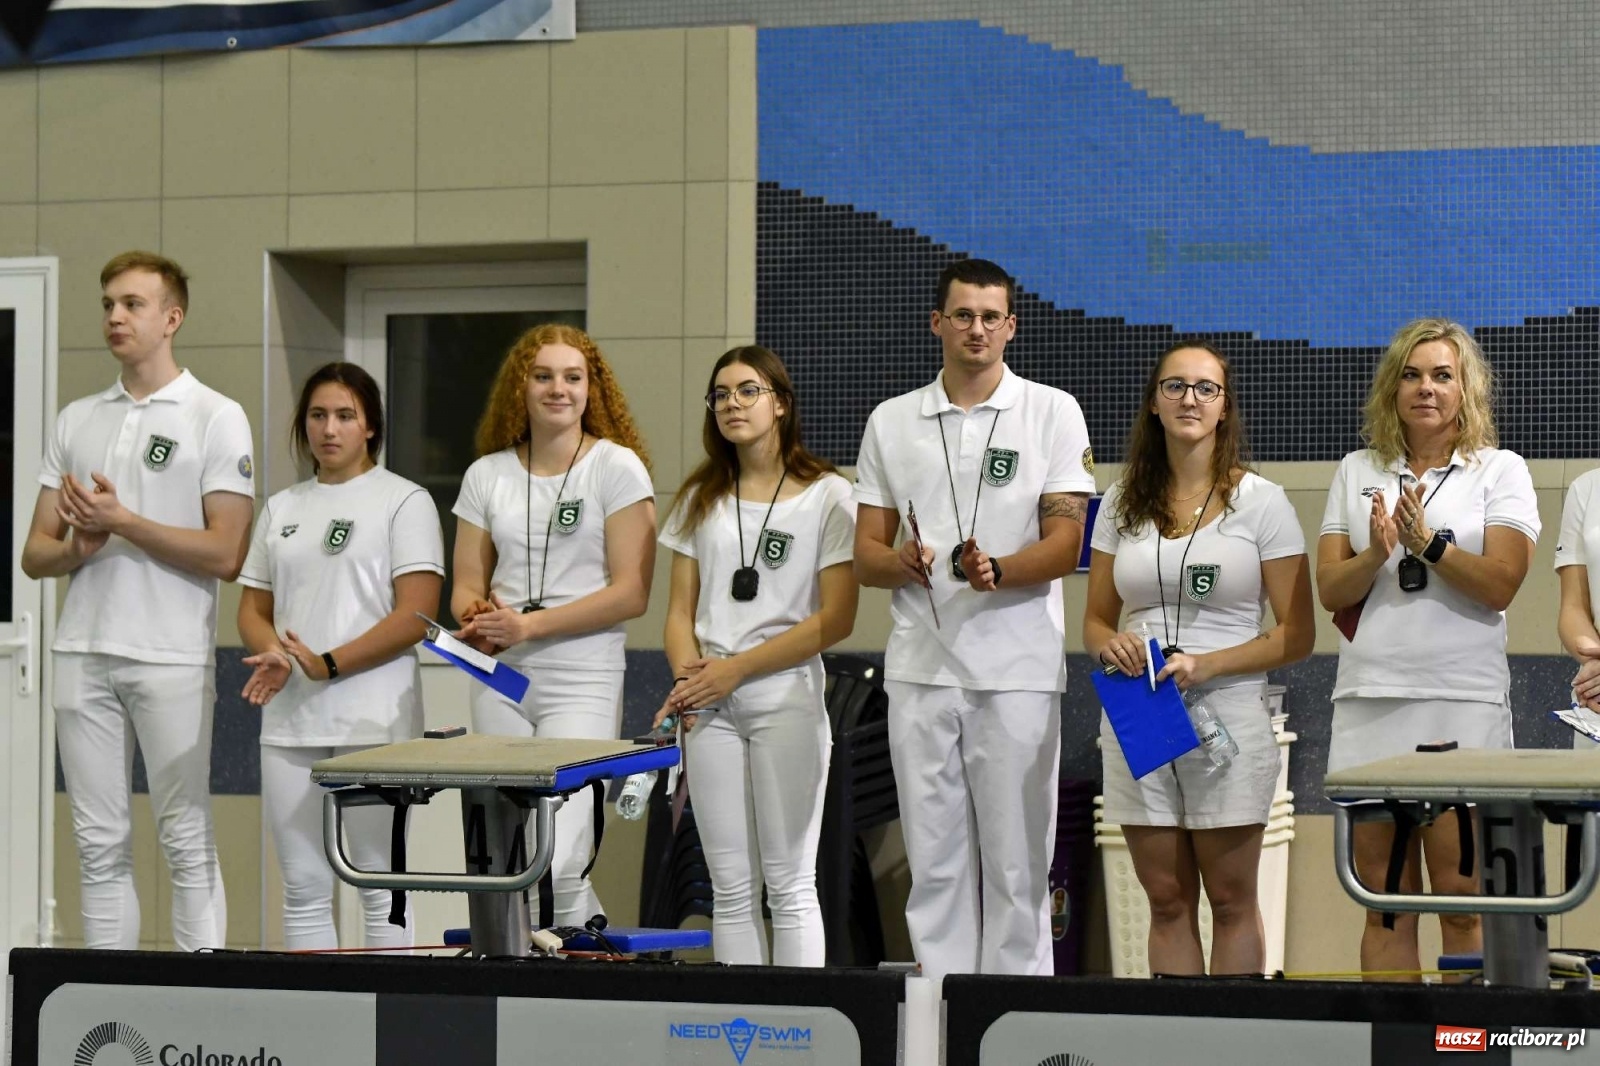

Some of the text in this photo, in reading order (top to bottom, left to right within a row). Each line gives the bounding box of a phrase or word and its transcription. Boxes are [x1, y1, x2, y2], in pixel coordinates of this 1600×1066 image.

[151, 446, 166, 462] S
[993, 460, 1007, 476] S
[561, 509, 575, 525] S
[331, 529, 346, 545] S
[768, 541, 781, 558] S
[1196, 576, 1210, 592] S
[467, 804, 492, 874] 4
[1483, 817, 1517, 896] 5
[670, 1024, 720, 1038] NEED
[758, 1027, 811, 1041] SWIM
